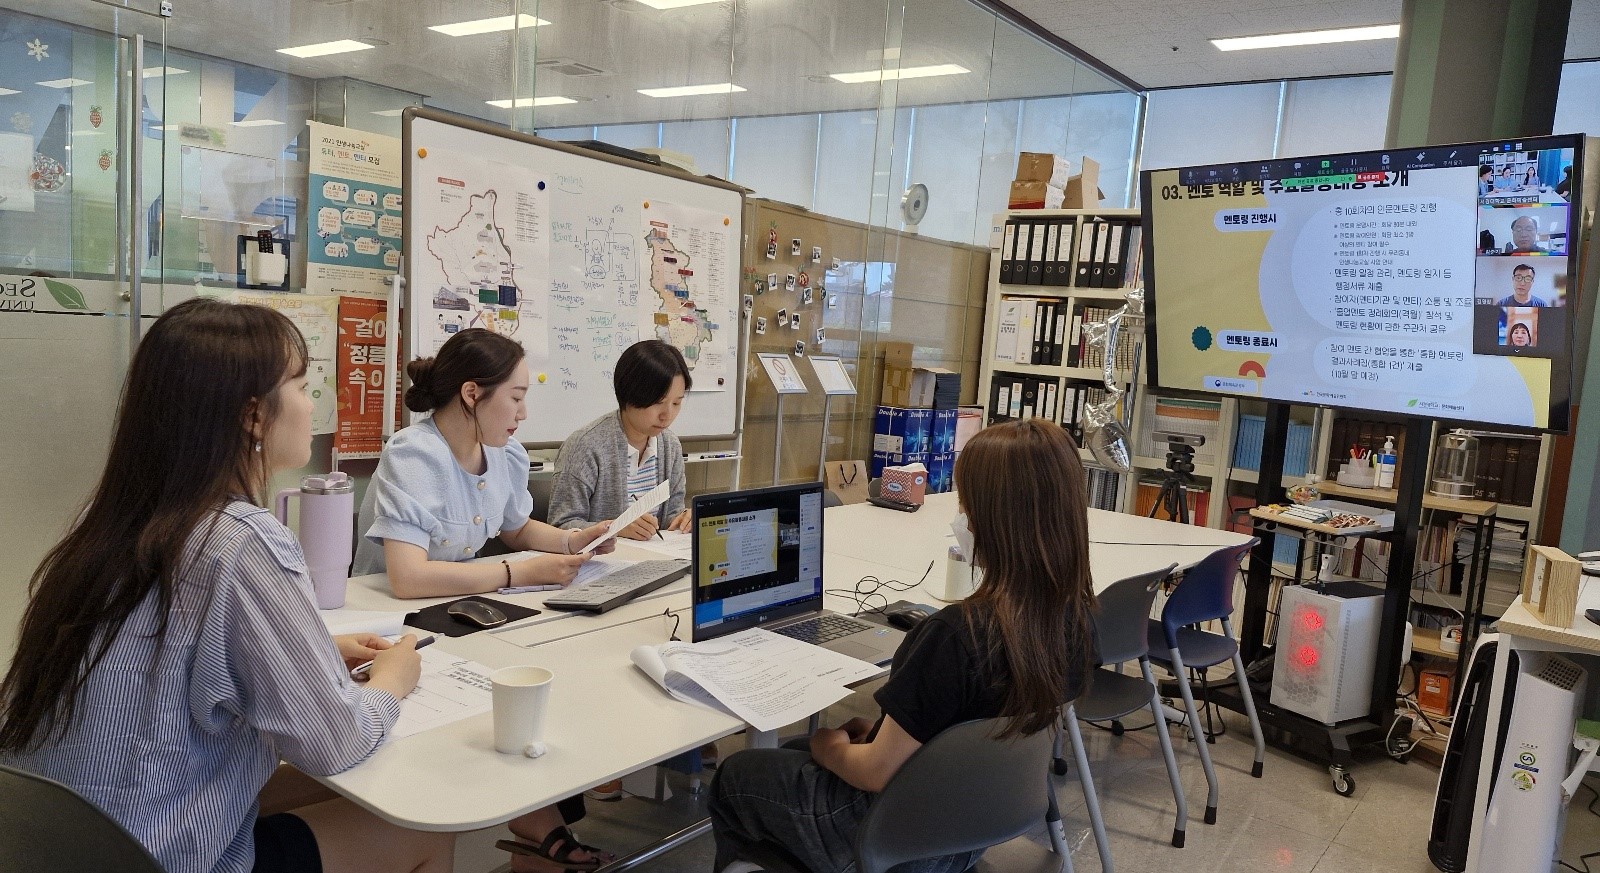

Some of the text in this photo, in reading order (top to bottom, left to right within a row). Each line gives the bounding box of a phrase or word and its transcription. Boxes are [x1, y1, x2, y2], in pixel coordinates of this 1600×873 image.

[1162, 185, 1182, 200] 03.
[1420, 203, 1437, 213] 진행
[1224, 213, 1277, 224] 멘토링 진행시
[1334, 268, 1357, 278] 멘토링
[1359, 269, 1374, 278] 일정
[1398, 269, 1420, 278] 멘토링
[1335, 282, 1365, 291] 행정서류
[1335, 320, 1358, 330] 멘토링
[1226, 335, 1278, 347] 멘토링 종료시
[1439, 351, 1464, 361] 멘토링
